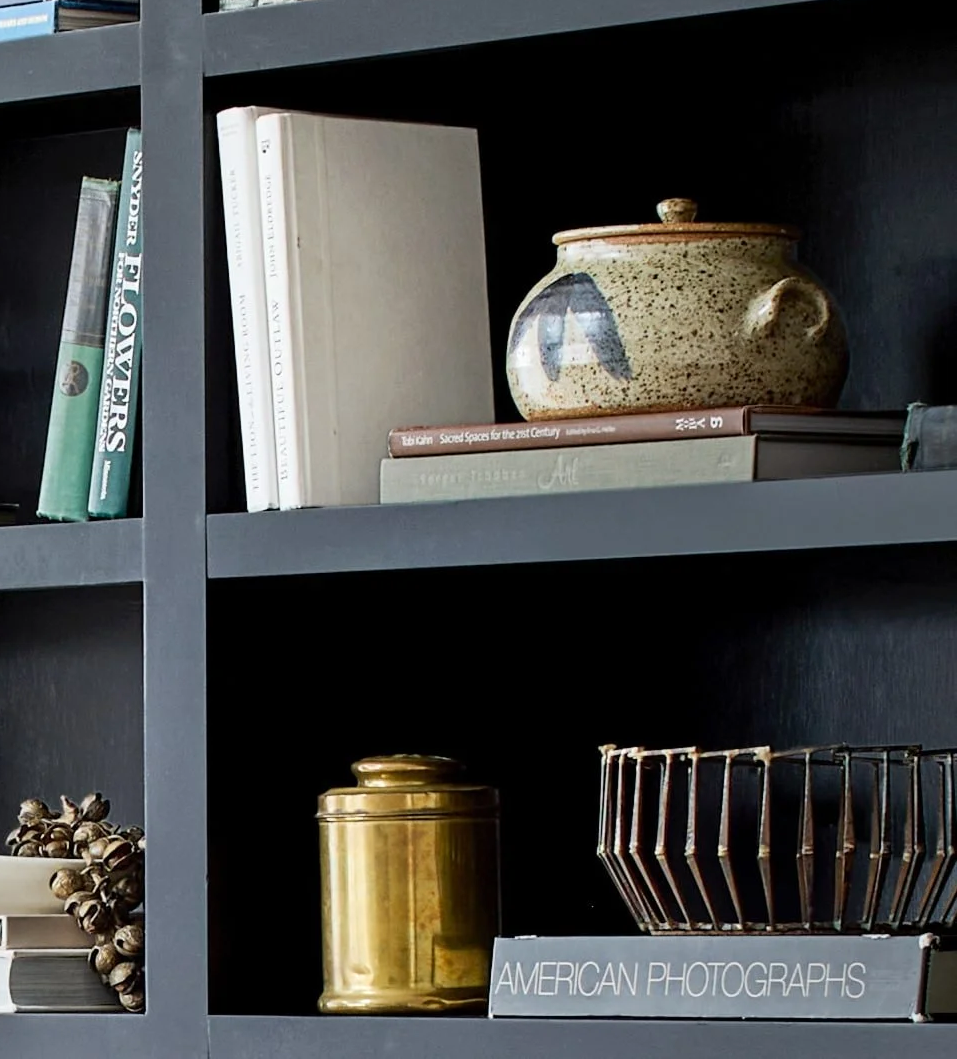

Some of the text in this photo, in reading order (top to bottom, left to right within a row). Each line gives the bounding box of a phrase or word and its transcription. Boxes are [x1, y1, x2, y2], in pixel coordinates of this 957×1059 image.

[125, 150, 144, 247] SNYDER
[227, 167, 240, 218] TUCKER
[237, 292, 250, 338] ROOM
[264, 173, 290, 482] BEAUTIFUL OUTLAW JOHN ELDREDGE
[98, 251, 126, 454] FOR NORTHERN GARDENS
[106, 252, 143, 453] FLOWERS
[243, 341, 255, 396] LIVING
[247, 420, 258, 458] LION
[401, 435, 416, 447] Tobi
[415, 433, 434, 446] Kahn
[439, 432, 464, 445] Sacred
[464, 431, 490, 446] Spaces
[490, 428, 502, 441] for
[502, 428, 515, 440] the
[516, 427, 530, 439] 21st
[530, 426, 561, 440] Century
[250, 462, 261, 493] THE
[494, 961, 867, 999] AMERICAN PHOTOGRAPHS
